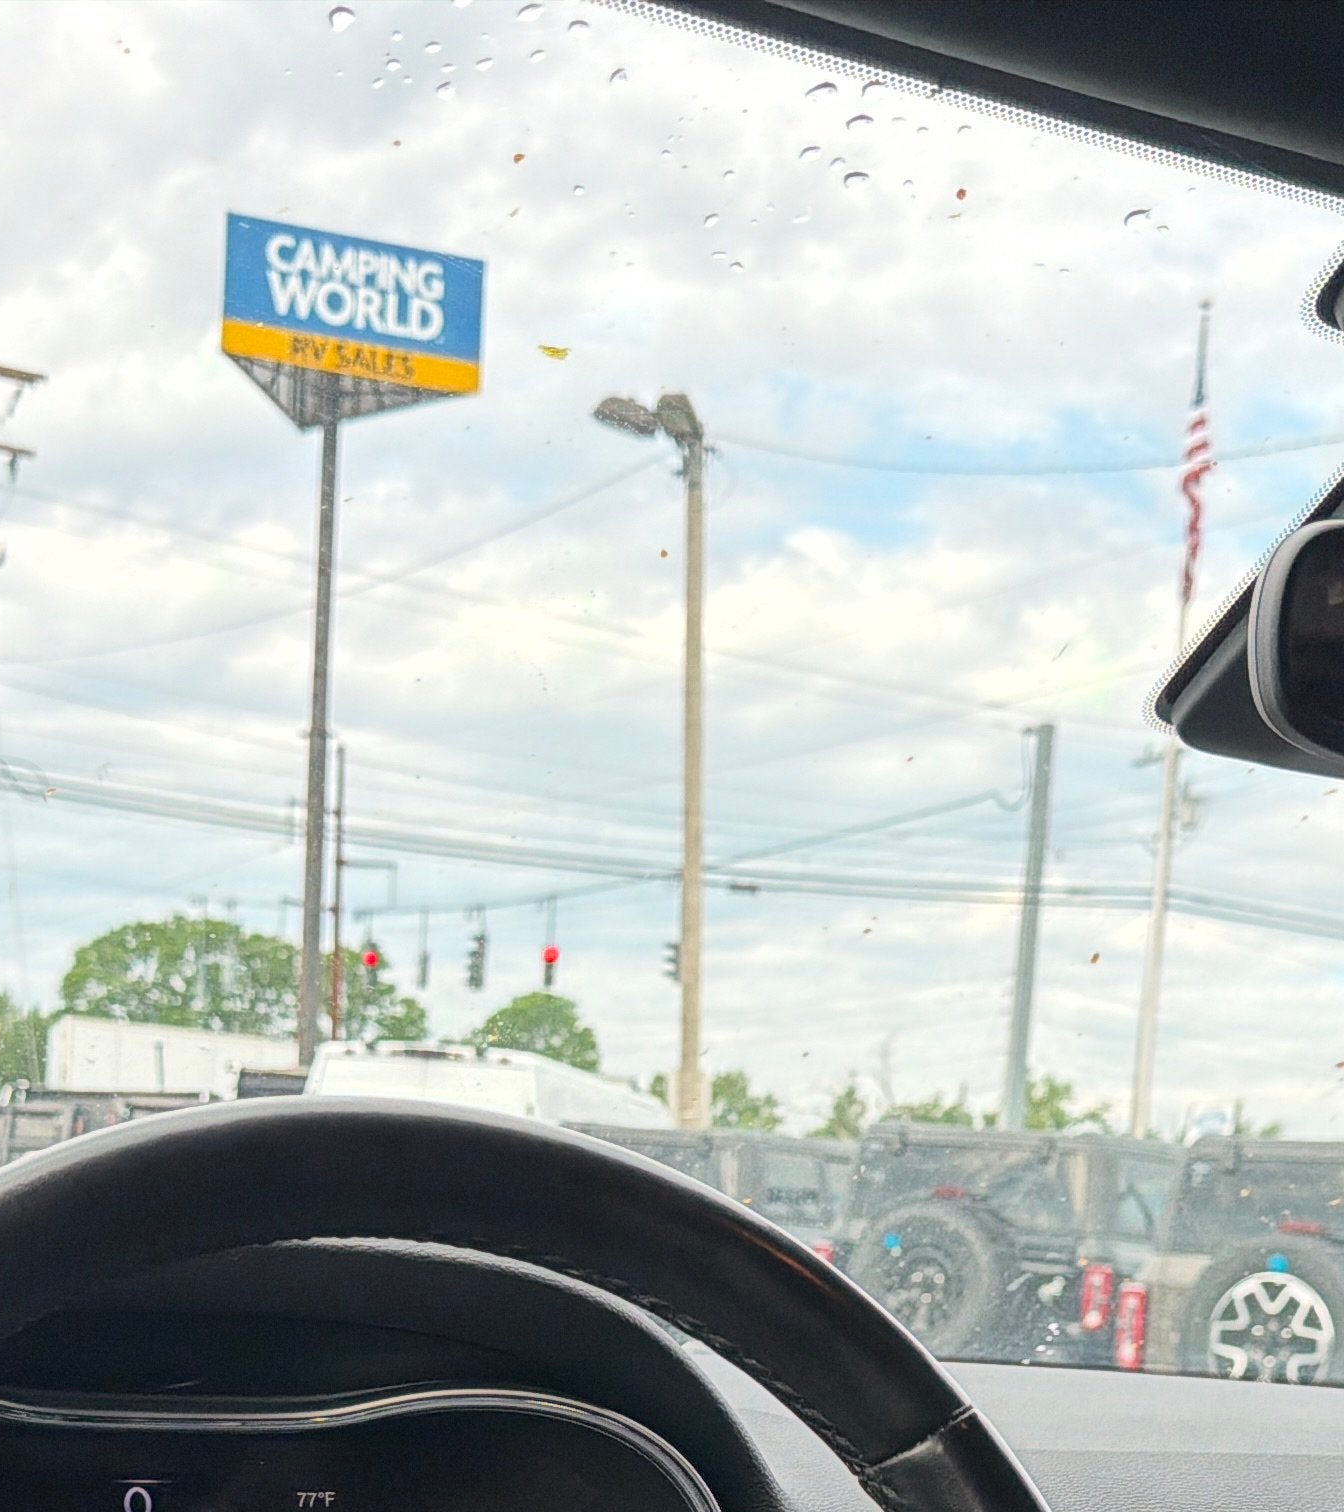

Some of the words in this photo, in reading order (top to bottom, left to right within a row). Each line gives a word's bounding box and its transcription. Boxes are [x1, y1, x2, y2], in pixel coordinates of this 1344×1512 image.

[265, 233, 444, 301] CAMPING
[267, 270, 443, 341] WORLD
[290, 336, 326, 360] RV
[335, 344, 416, 379] SALES
[296, 1491, 336, 1508] 77°F
